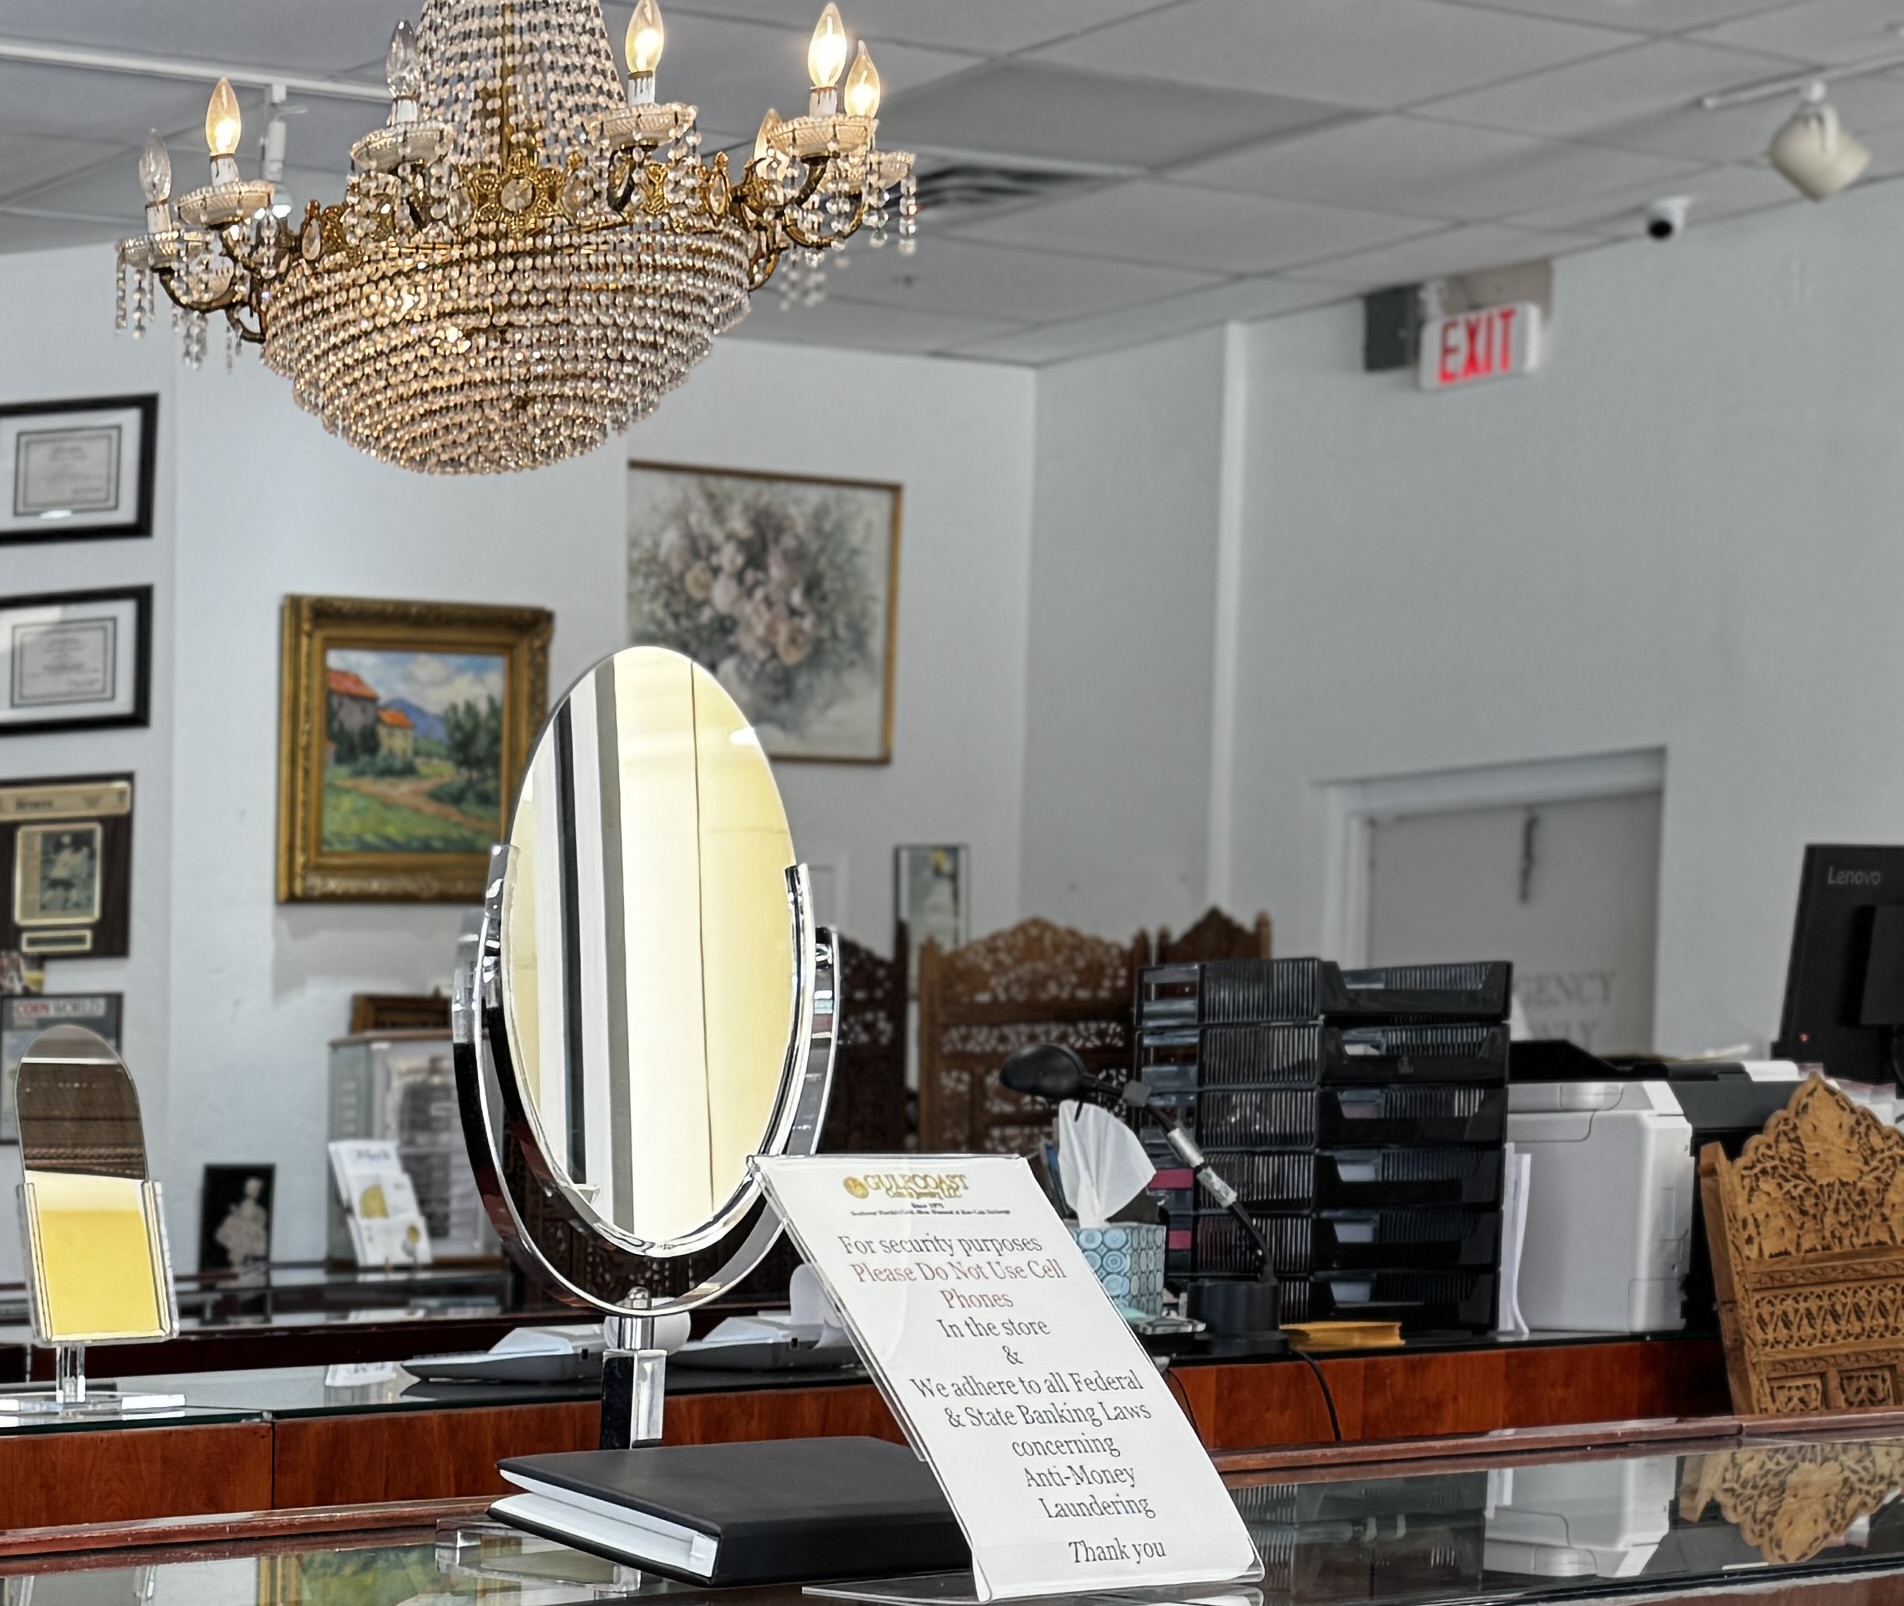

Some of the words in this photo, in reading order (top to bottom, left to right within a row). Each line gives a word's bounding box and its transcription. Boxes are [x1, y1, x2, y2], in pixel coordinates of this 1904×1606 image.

[1438, 308, 1517, 385] EXIT
[1828, 866, 1881, 885] Lenovo
[15, 1001, 50, 1016] COIN
[863, 1173, 969, 1191] GULFCOAST
[838, 1235, 876, 1255] For
[880, 1233, 955, 1257] security
[957, 1235, 1043, 1257] purposes
[850, 1263, 917, 1283] Please
[915, 1262, 949, 1281] Do
[948, 1261, 986, 1281] Not
[987, 1261, 1028, 1280] Use
[1027, 1259, 1067, 1279] Cell
[940, 1288, 1014, 1309] Phones
[936, 1318, 965, 1338] In
[964, 1316, 1000, 1337] the
[1001, 1318, 1051, 1337] store
[1002, 1345, 1024, 1365] &
[909, 1377, 949, 1399] We
[951, 1375, 1019, 1397] adhere
[1019, 1377, 1042, 1395] to
[1043, 1371, 1070, 1394] all
[1068, 1369, 1144, 1393] Federal
[944, 1407, 966, 1428] &
[964, 1405, 1018, 1427] State
[1016, 1402, 1103, 1428] Banking
[1097, 1401, 1152, 1422] Laws
[1011, 1432, 1121, 1458] concerning
[1024, 1464, 1136, 1489] Anti-Money
[1038, 1493, 1156, 1519] Laundering
[1068, 1538, 1130, 1564] Thank
[1131, 1540, 1167, 1565] you
